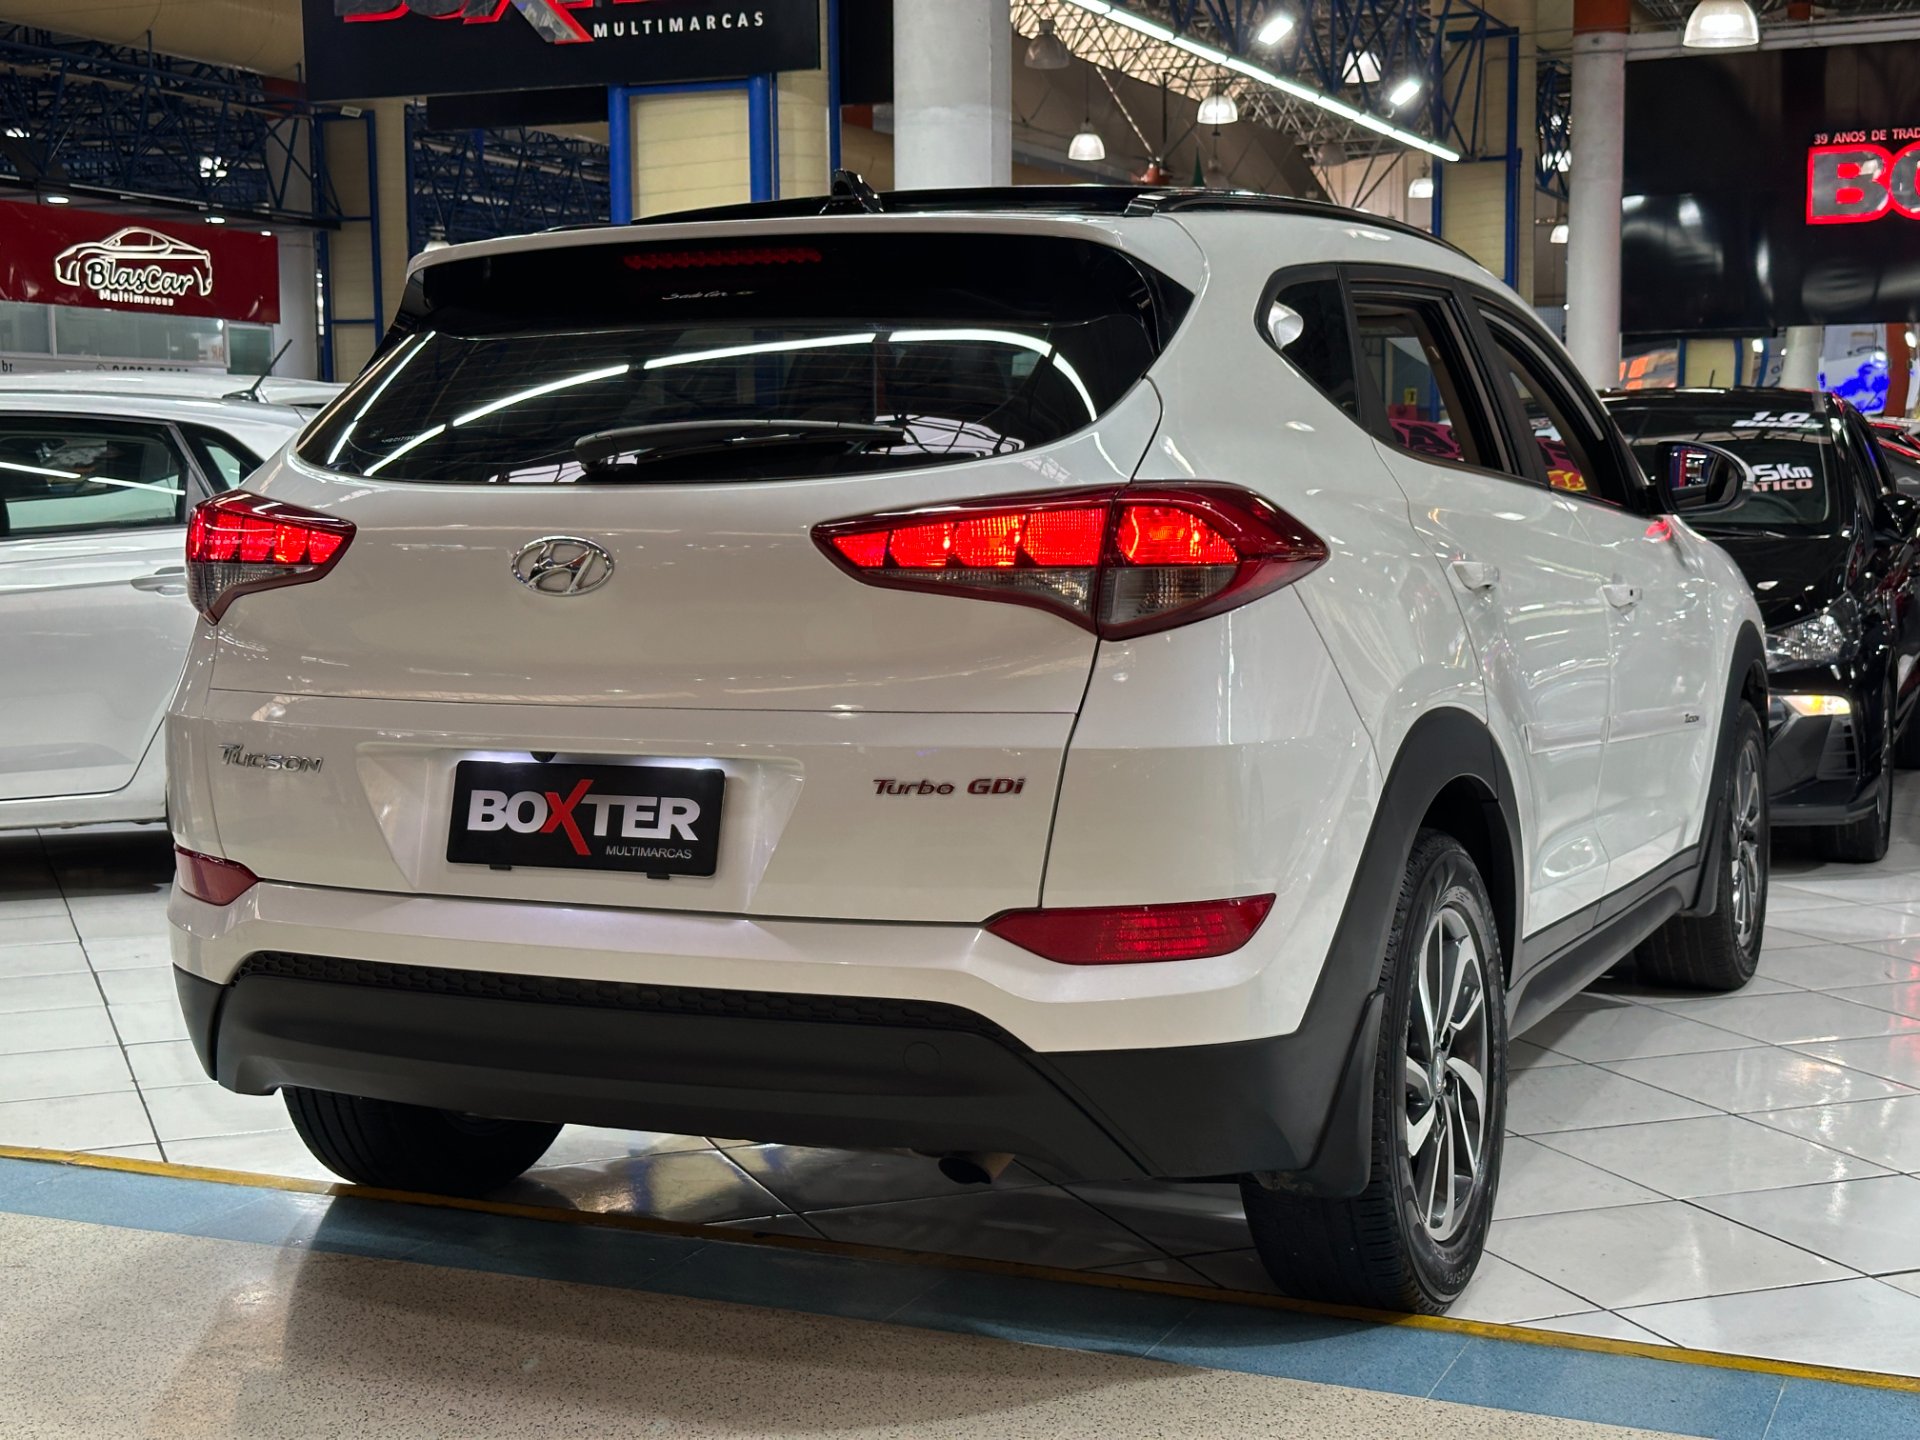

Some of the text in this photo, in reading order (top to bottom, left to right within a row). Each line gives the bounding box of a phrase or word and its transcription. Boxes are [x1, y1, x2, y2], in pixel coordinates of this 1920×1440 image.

[593, 11, 764, 38] MULTIMARCAS
[1814, 133, 1829, 145] 39
[1833, 130, 1866, 144] ANOS
[1871, 129, 1887, 141] DE
[85, 258, 194, 296] BlasCar
[99, 289, 174, 307] Multimarcas
[873, 777, 1026, 795] Turbo GDi
[467, 779, 701, 856] BOXTER
[605, 845, 693, 859] MULTIMARCAS
